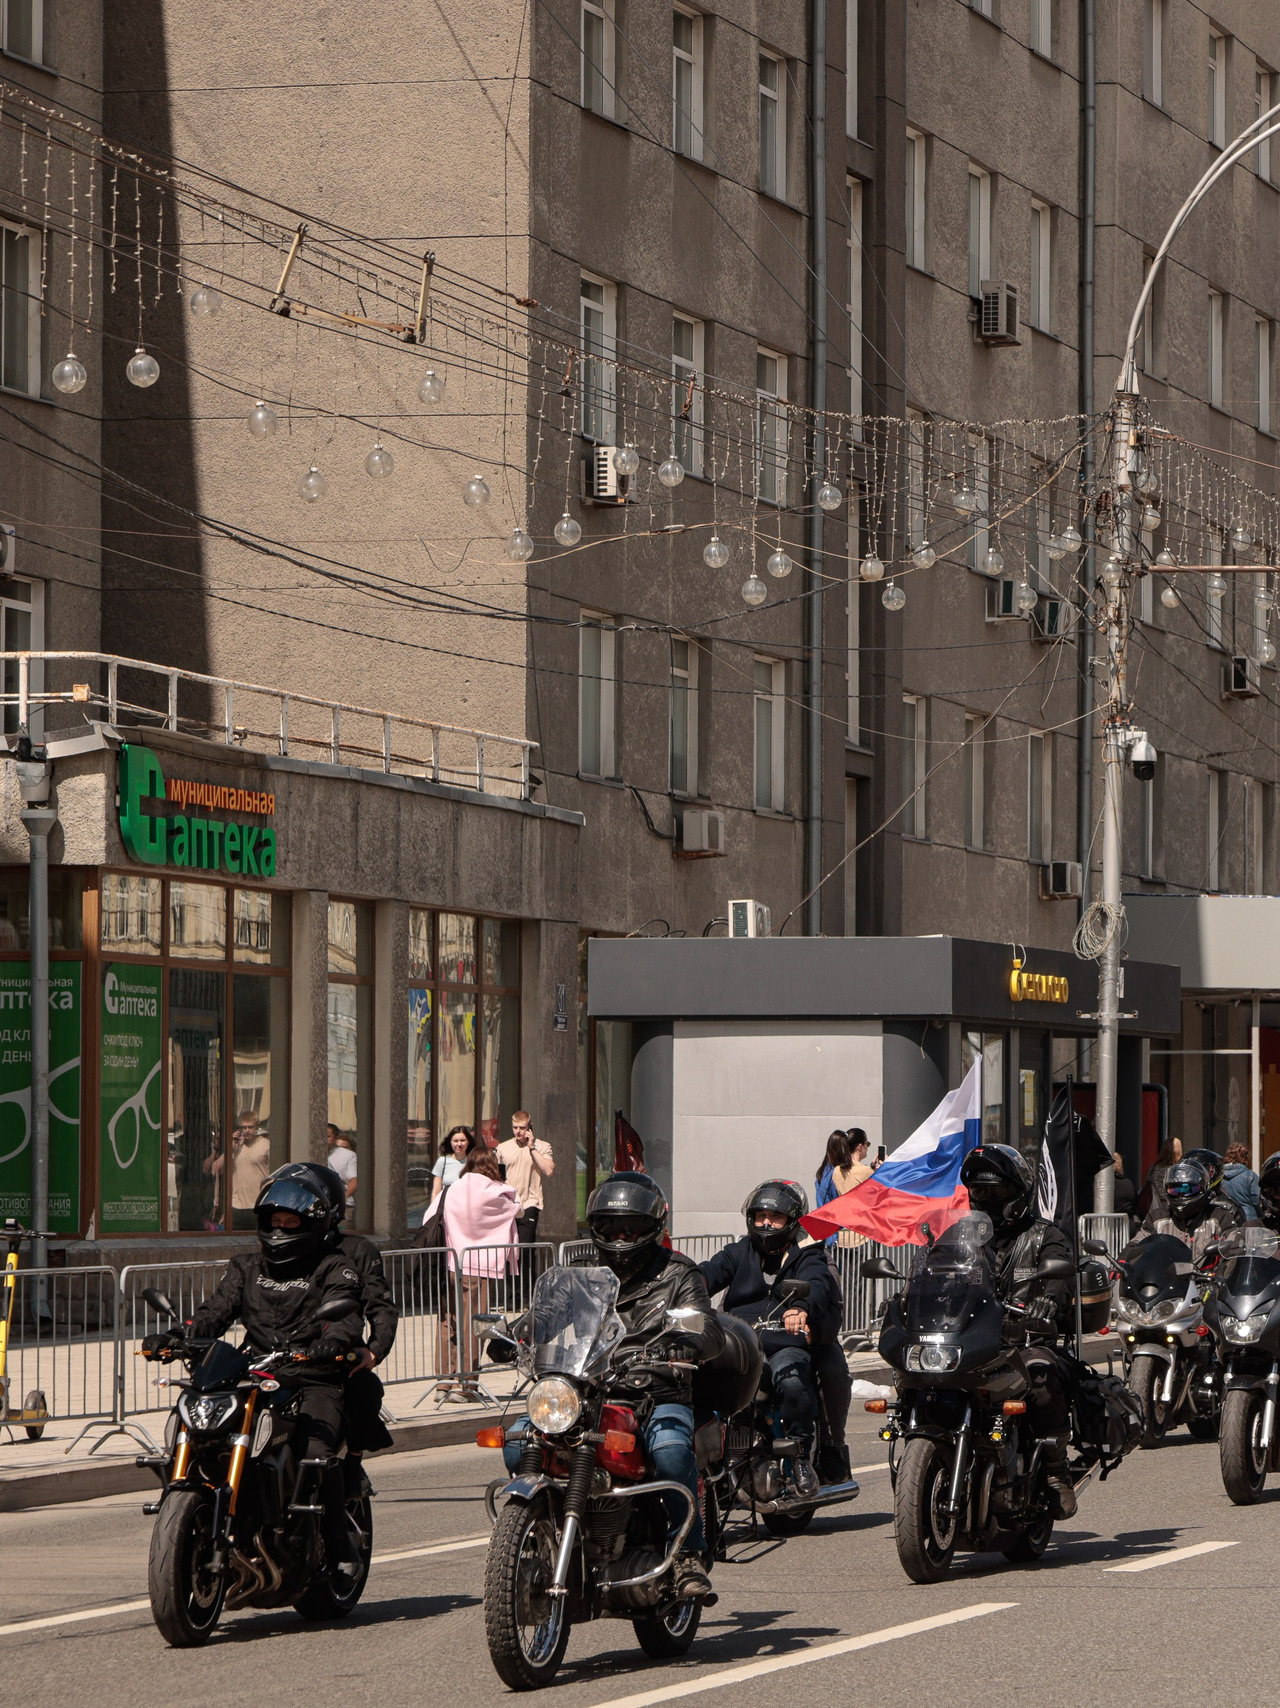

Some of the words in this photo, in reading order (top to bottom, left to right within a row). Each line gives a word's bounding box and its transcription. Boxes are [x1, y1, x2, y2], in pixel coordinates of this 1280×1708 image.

[169, 779, 275, 815] муниципальная
[172, 815, 277, 878] аптека
[120, 996, 157, 1017] аптека
